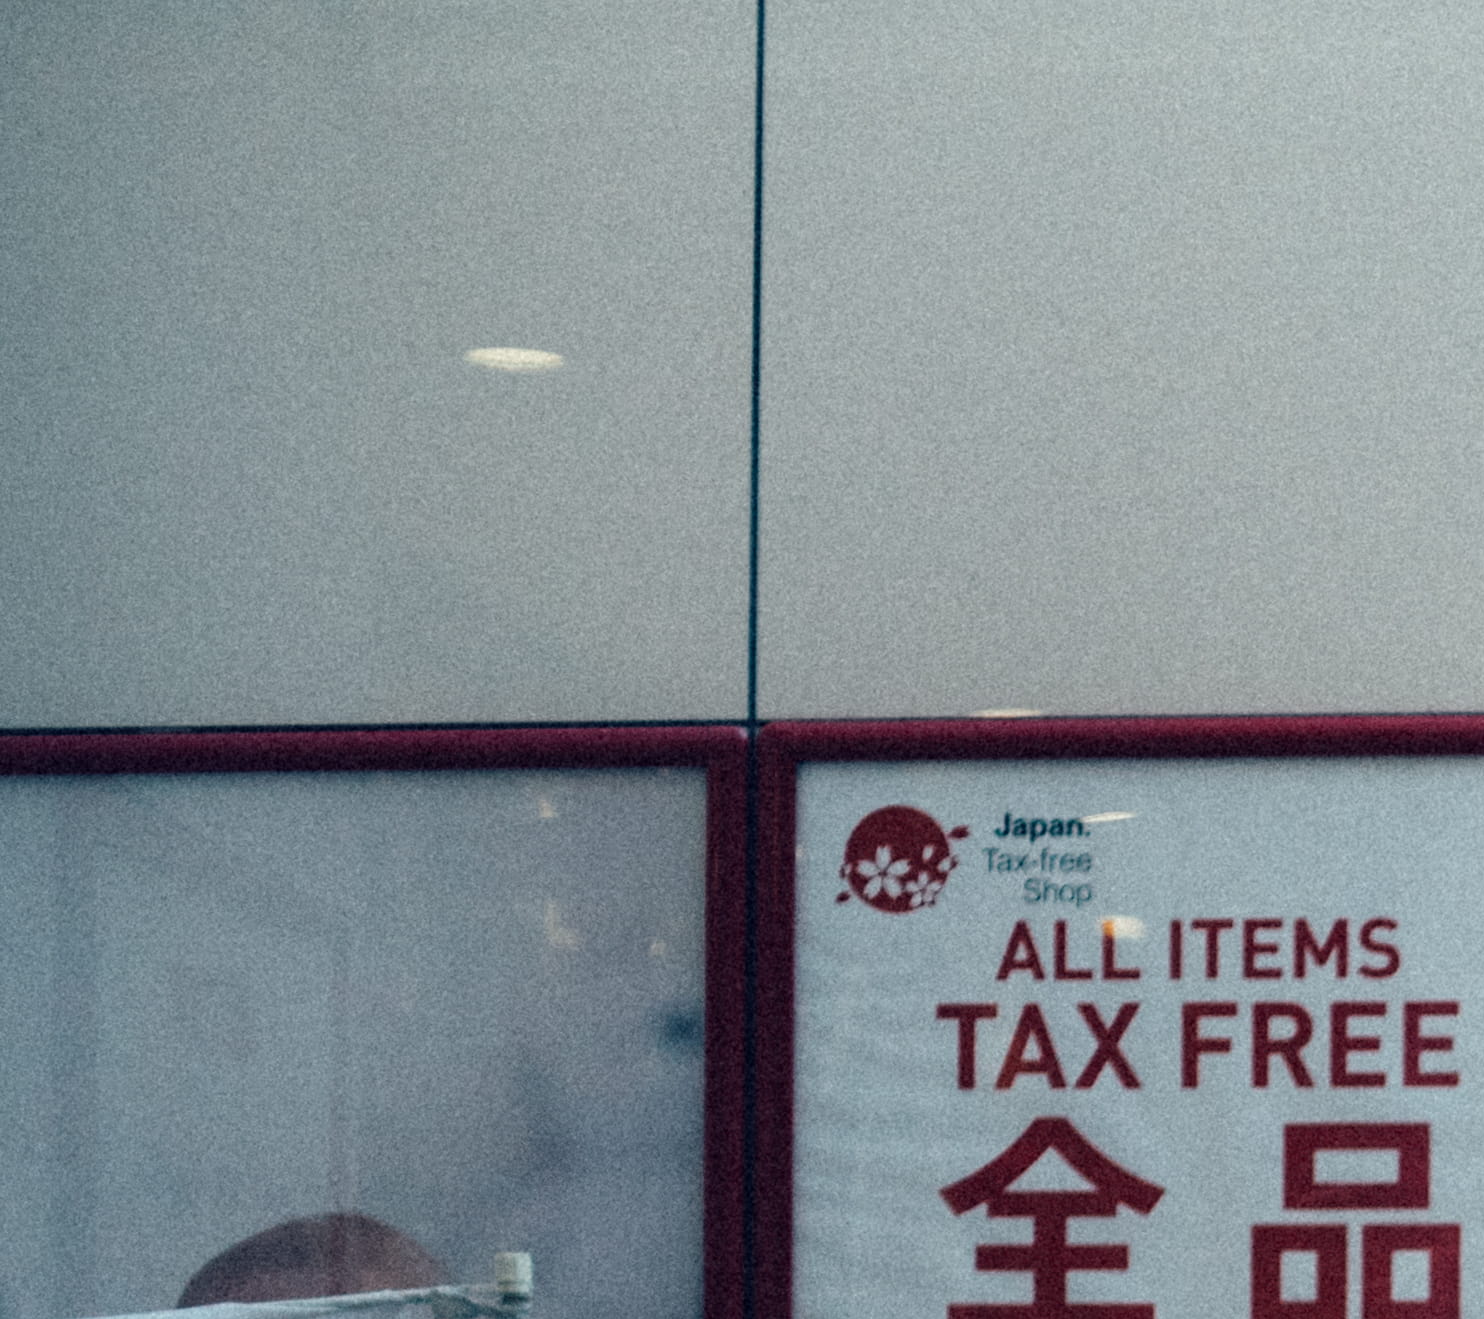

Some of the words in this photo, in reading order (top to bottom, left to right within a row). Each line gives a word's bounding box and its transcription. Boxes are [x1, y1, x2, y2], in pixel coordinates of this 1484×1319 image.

[981, 847, 1093, 874] Tax-free
[1023, 877, 1093, 908] Shop
[995, 919, 1141, 980] ALL
[1170, 917, 1401, 980] ITEMS
[936, 1001, 1143, 1091] TAX
[1181, 1001, 1462, 1089] FREE
